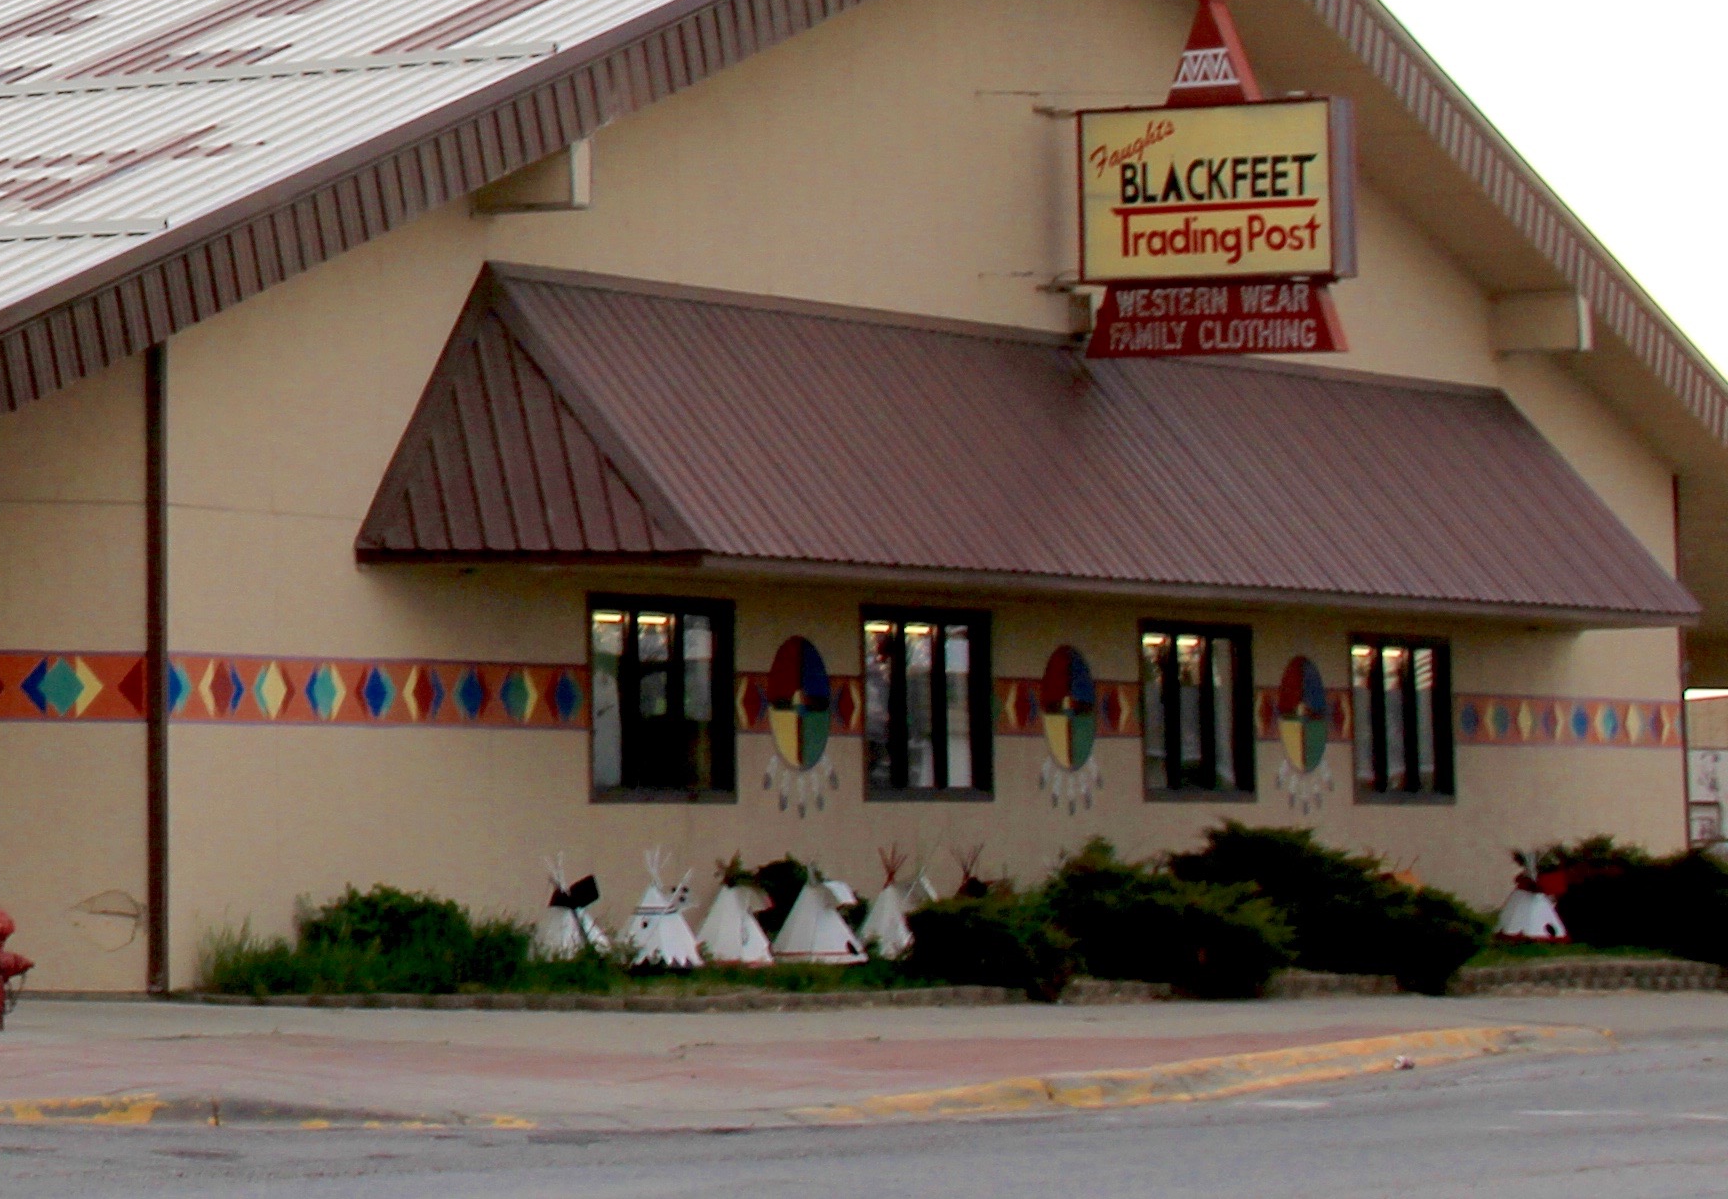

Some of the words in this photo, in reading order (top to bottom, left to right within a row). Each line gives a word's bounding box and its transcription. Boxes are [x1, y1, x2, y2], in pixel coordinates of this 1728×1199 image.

[1120, 154, 1317, 204] BLACKFEET
[1112, 200, 1244, 265] Trading
[1246, 213, 1321, 252] Post
[1115, 286, 1229, 318] WESTERN
[1240, 283, 1310, 313] WEAR
[1108, 320, 1188, 351] FAMILY
[1198, 318, 1317, 349] CLOTHING
